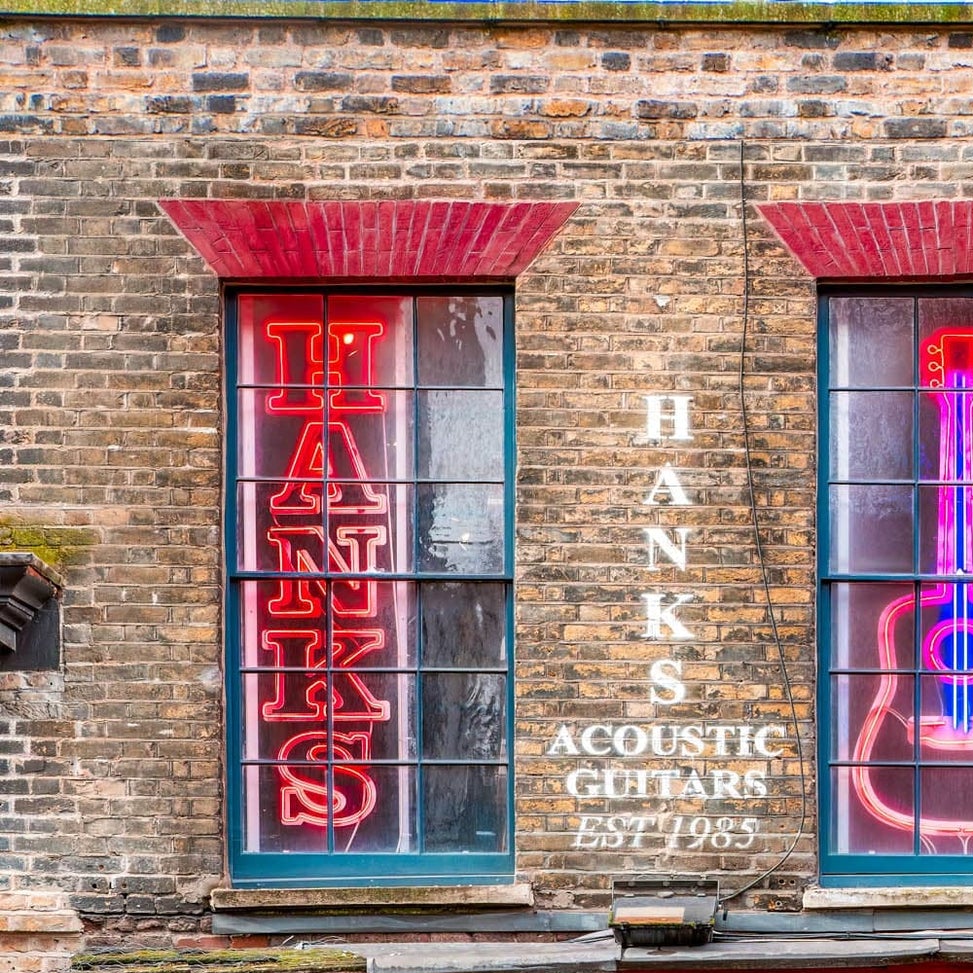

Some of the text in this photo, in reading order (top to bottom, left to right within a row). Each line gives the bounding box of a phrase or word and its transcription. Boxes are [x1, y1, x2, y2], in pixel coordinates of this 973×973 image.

[640, 395, 695, 705] HANKS
[262, 322, 390, 827] HANKS
[547, 724, 785, 758] ACOUSTIC
[566, 768, 768, 800] GUITARS
[571, 815, 760, 851] EST 1985
